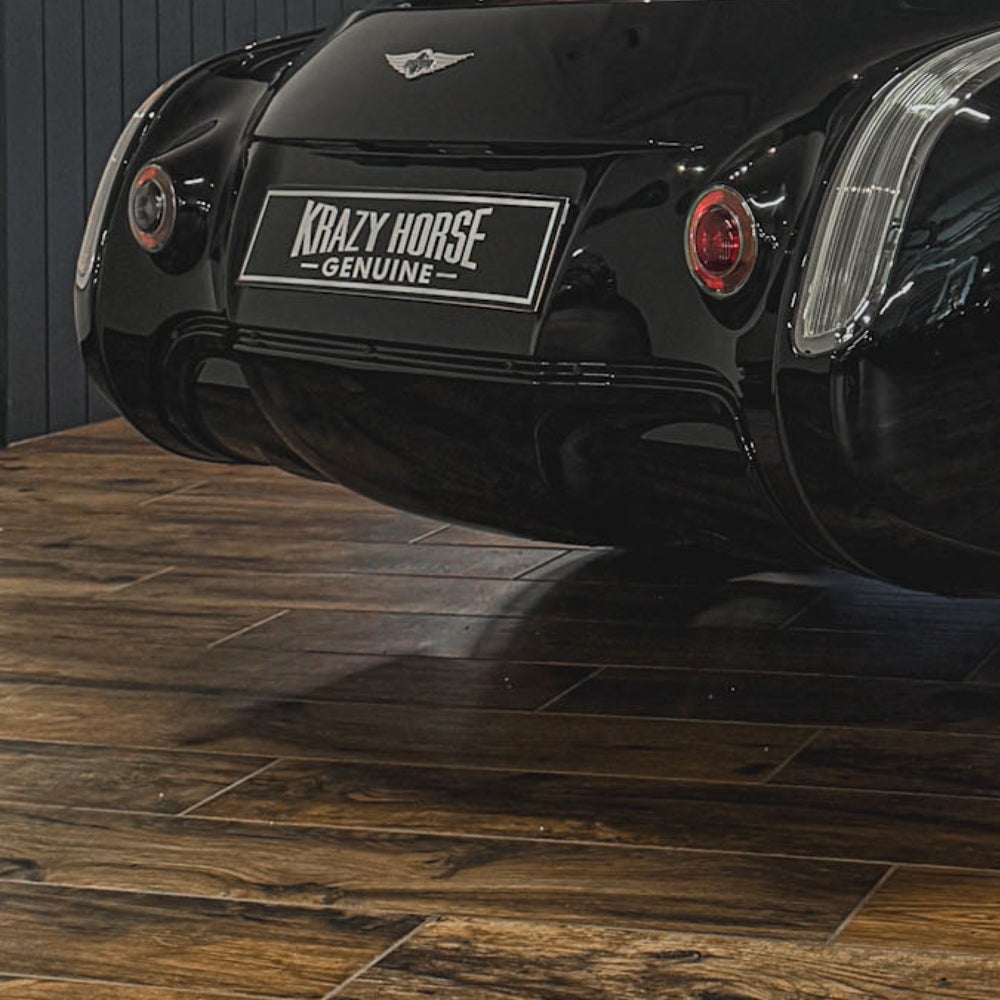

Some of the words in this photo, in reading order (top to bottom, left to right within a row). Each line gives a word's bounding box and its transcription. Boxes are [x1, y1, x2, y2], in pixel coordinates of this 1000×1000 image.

[290, 199, 391, 258] KRAZY
[387, 207, 494, 270] HORSE
[321, 256, 434, 284] GENUINE
